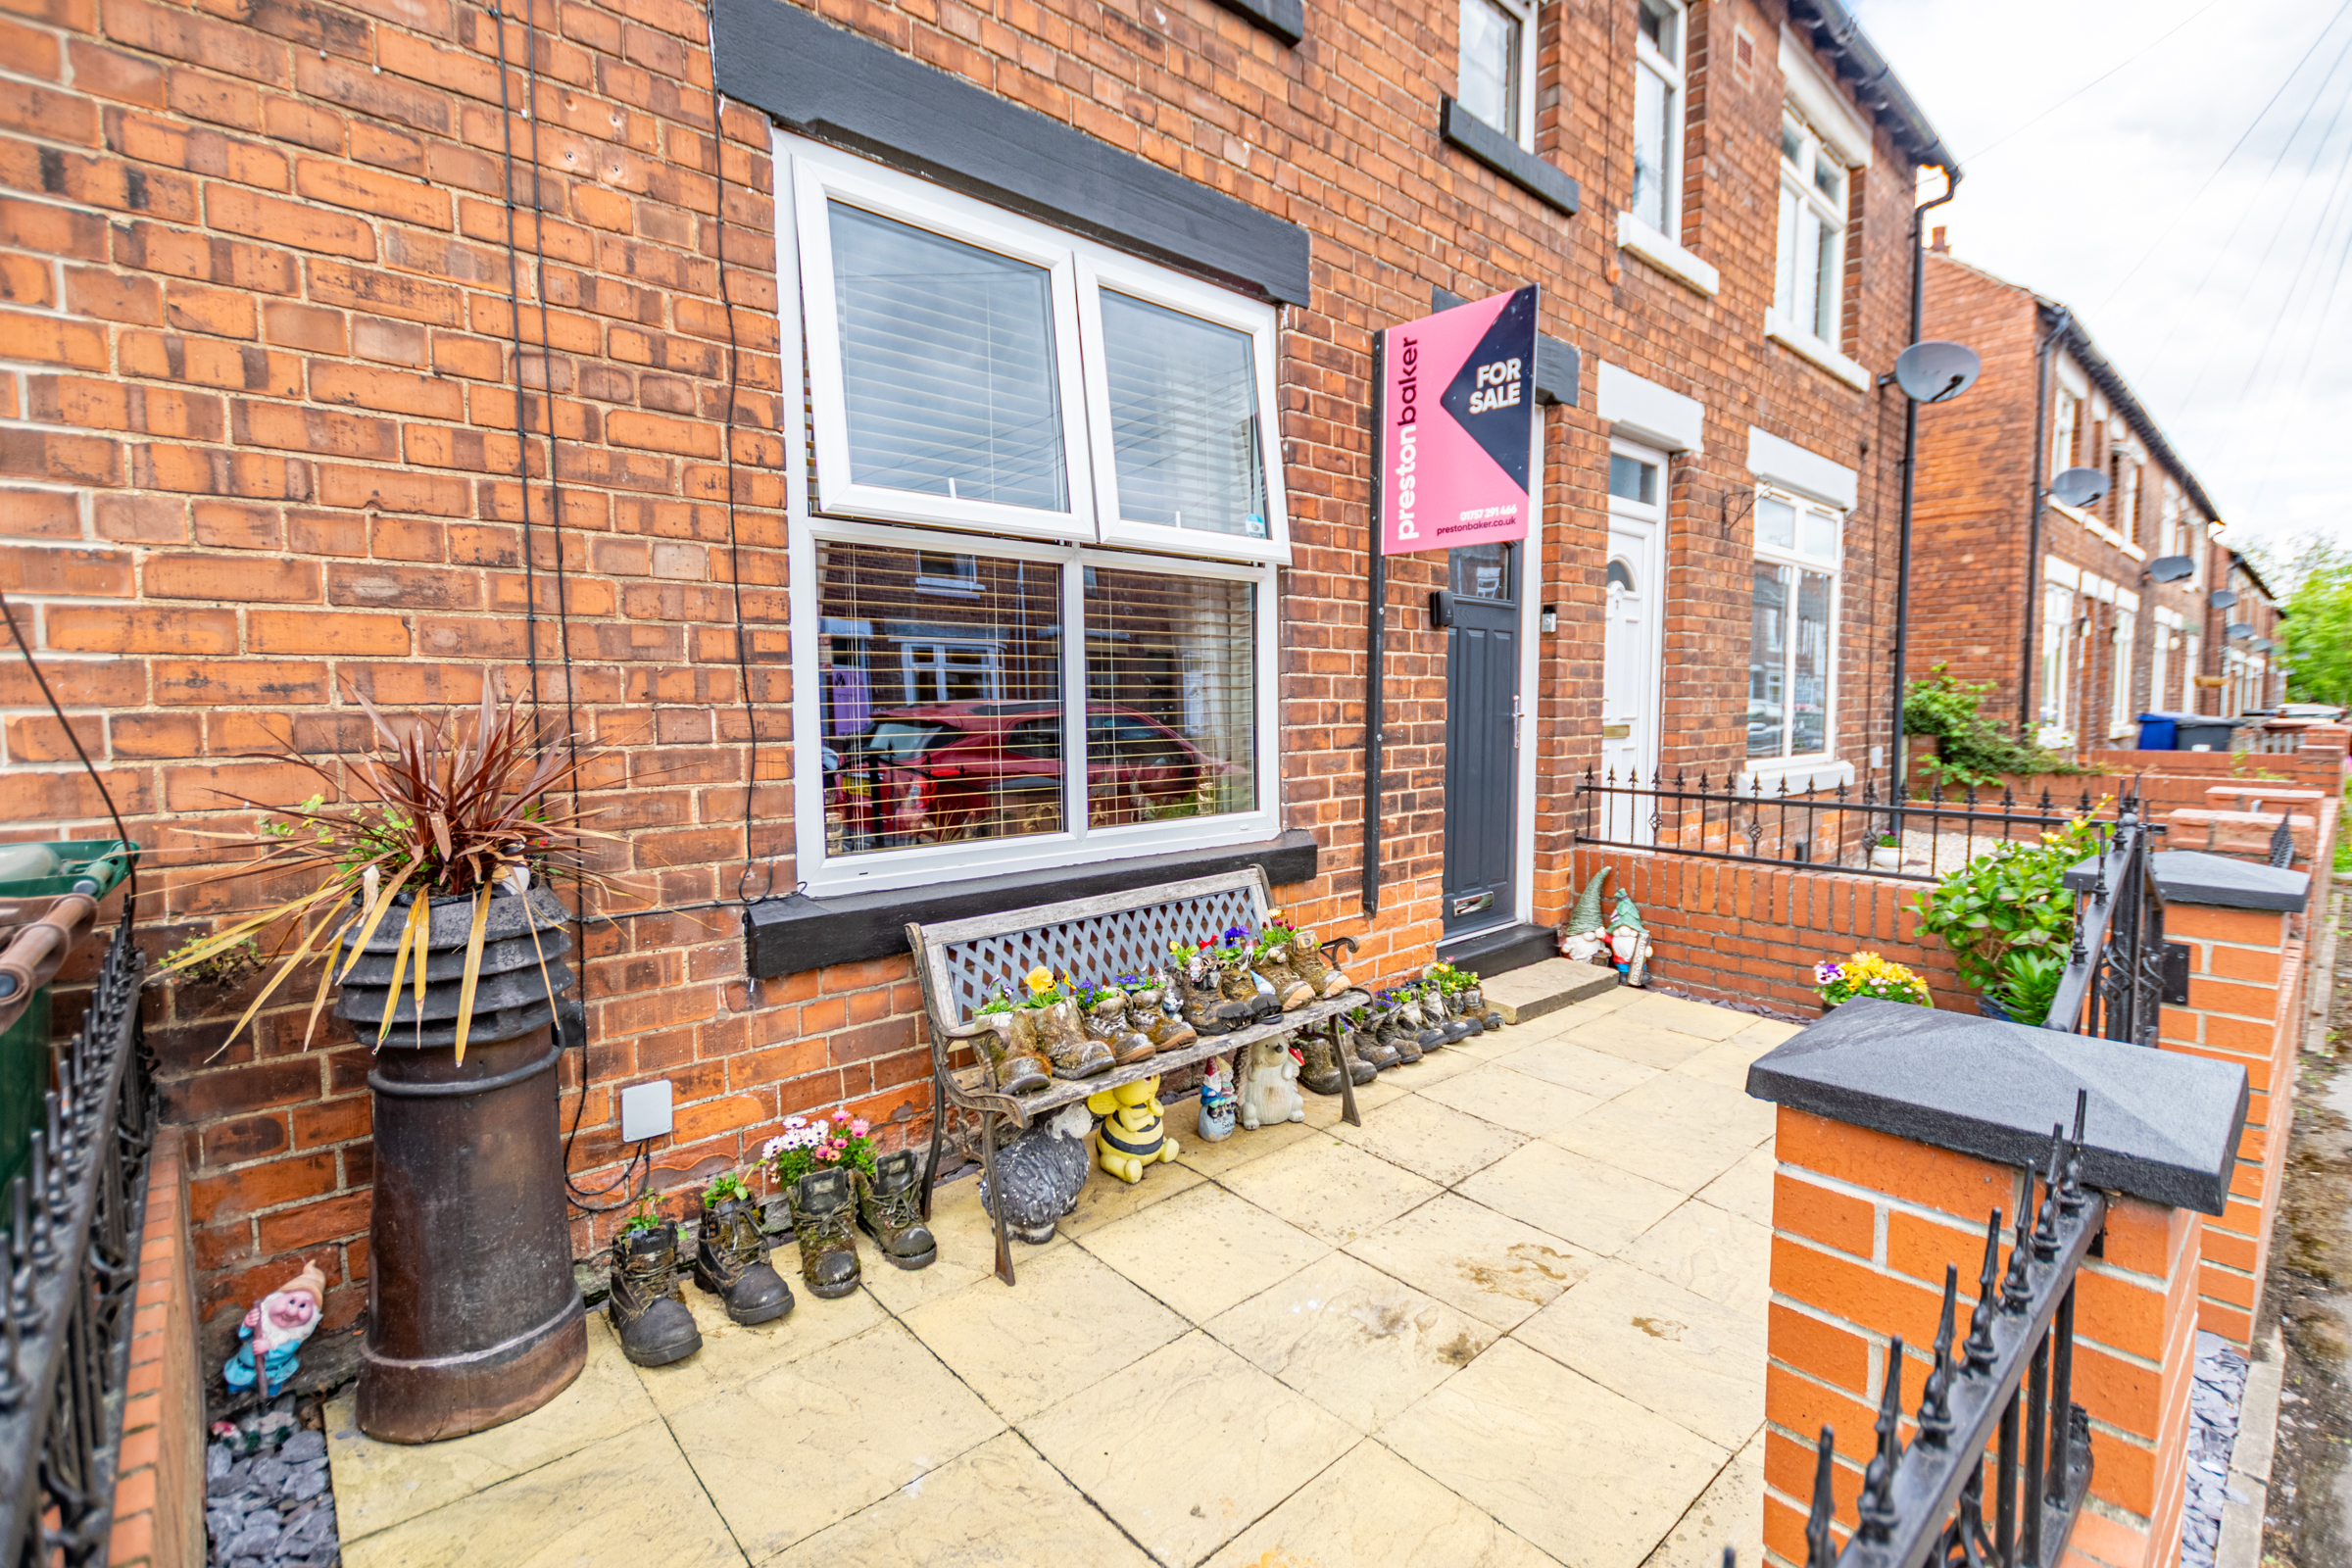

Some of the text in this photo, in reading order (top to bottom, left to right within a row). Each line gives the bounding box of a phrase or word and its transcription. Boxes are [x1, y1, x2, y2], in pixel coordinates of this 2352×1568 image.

[1477, 358, 1522, 389] FOR
[1469, 382, 1521, 415] SALE
[1459, 504, 1517, 522] 01757 291 466
[1436, 516, 1516, 536] prestonbaker.co.uk
